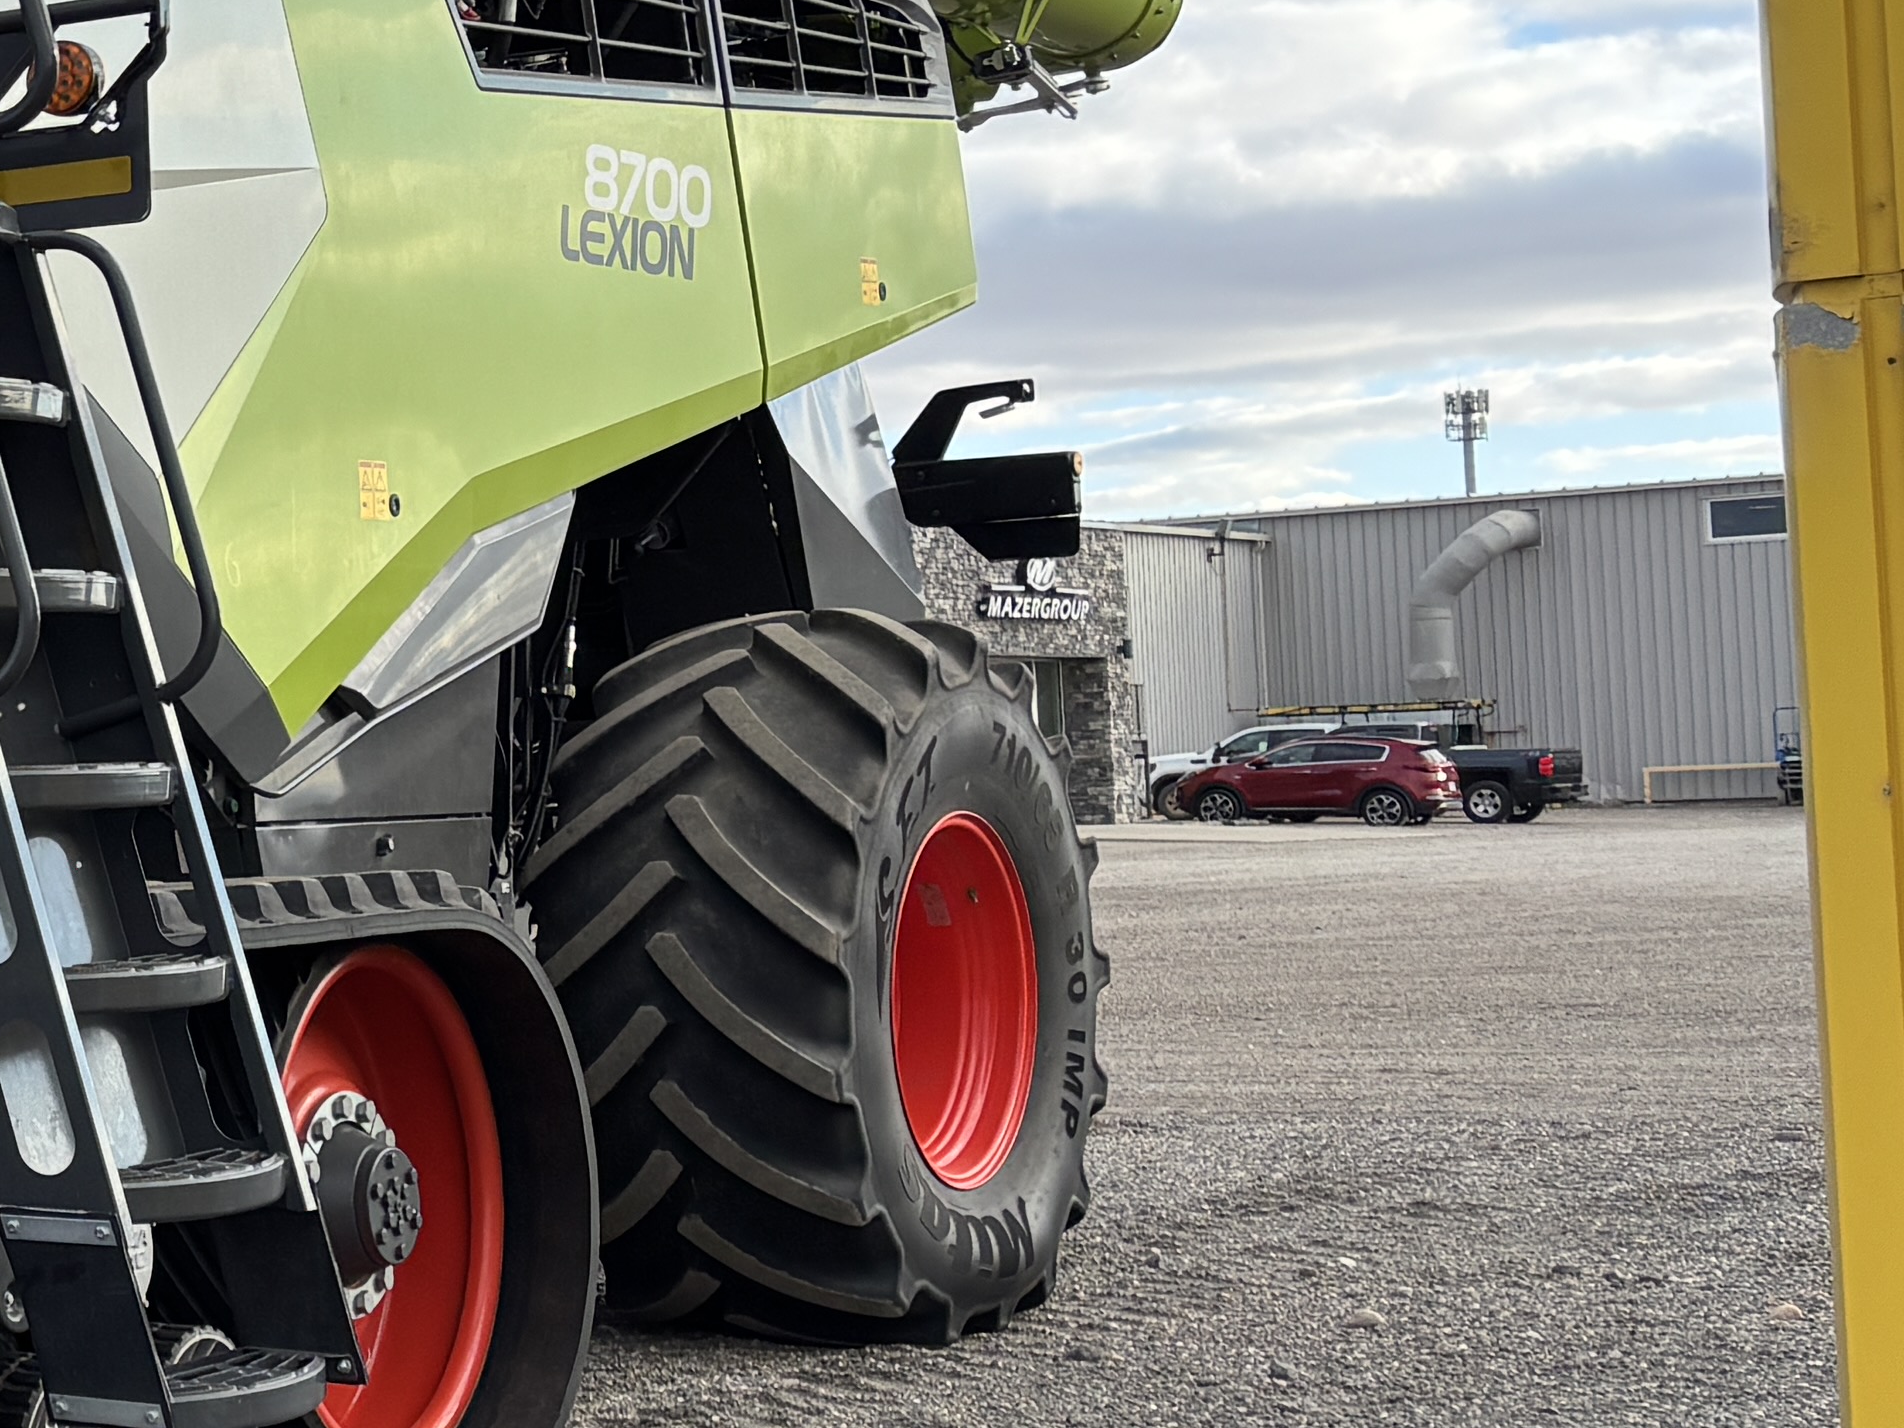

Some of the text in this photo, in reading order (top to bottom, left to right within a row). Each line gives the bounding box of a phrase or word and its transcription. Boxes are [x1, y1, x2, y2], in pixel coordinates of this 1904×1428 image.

[584, 143, 712, 229] 8700
[560, 204, 695, 280] LEXION
[986, 595, 1090, 621] MAZERGROUP
[1065, 930, 1089, 1005] 30
[1059, 1028, 1087, 1140] IMP
